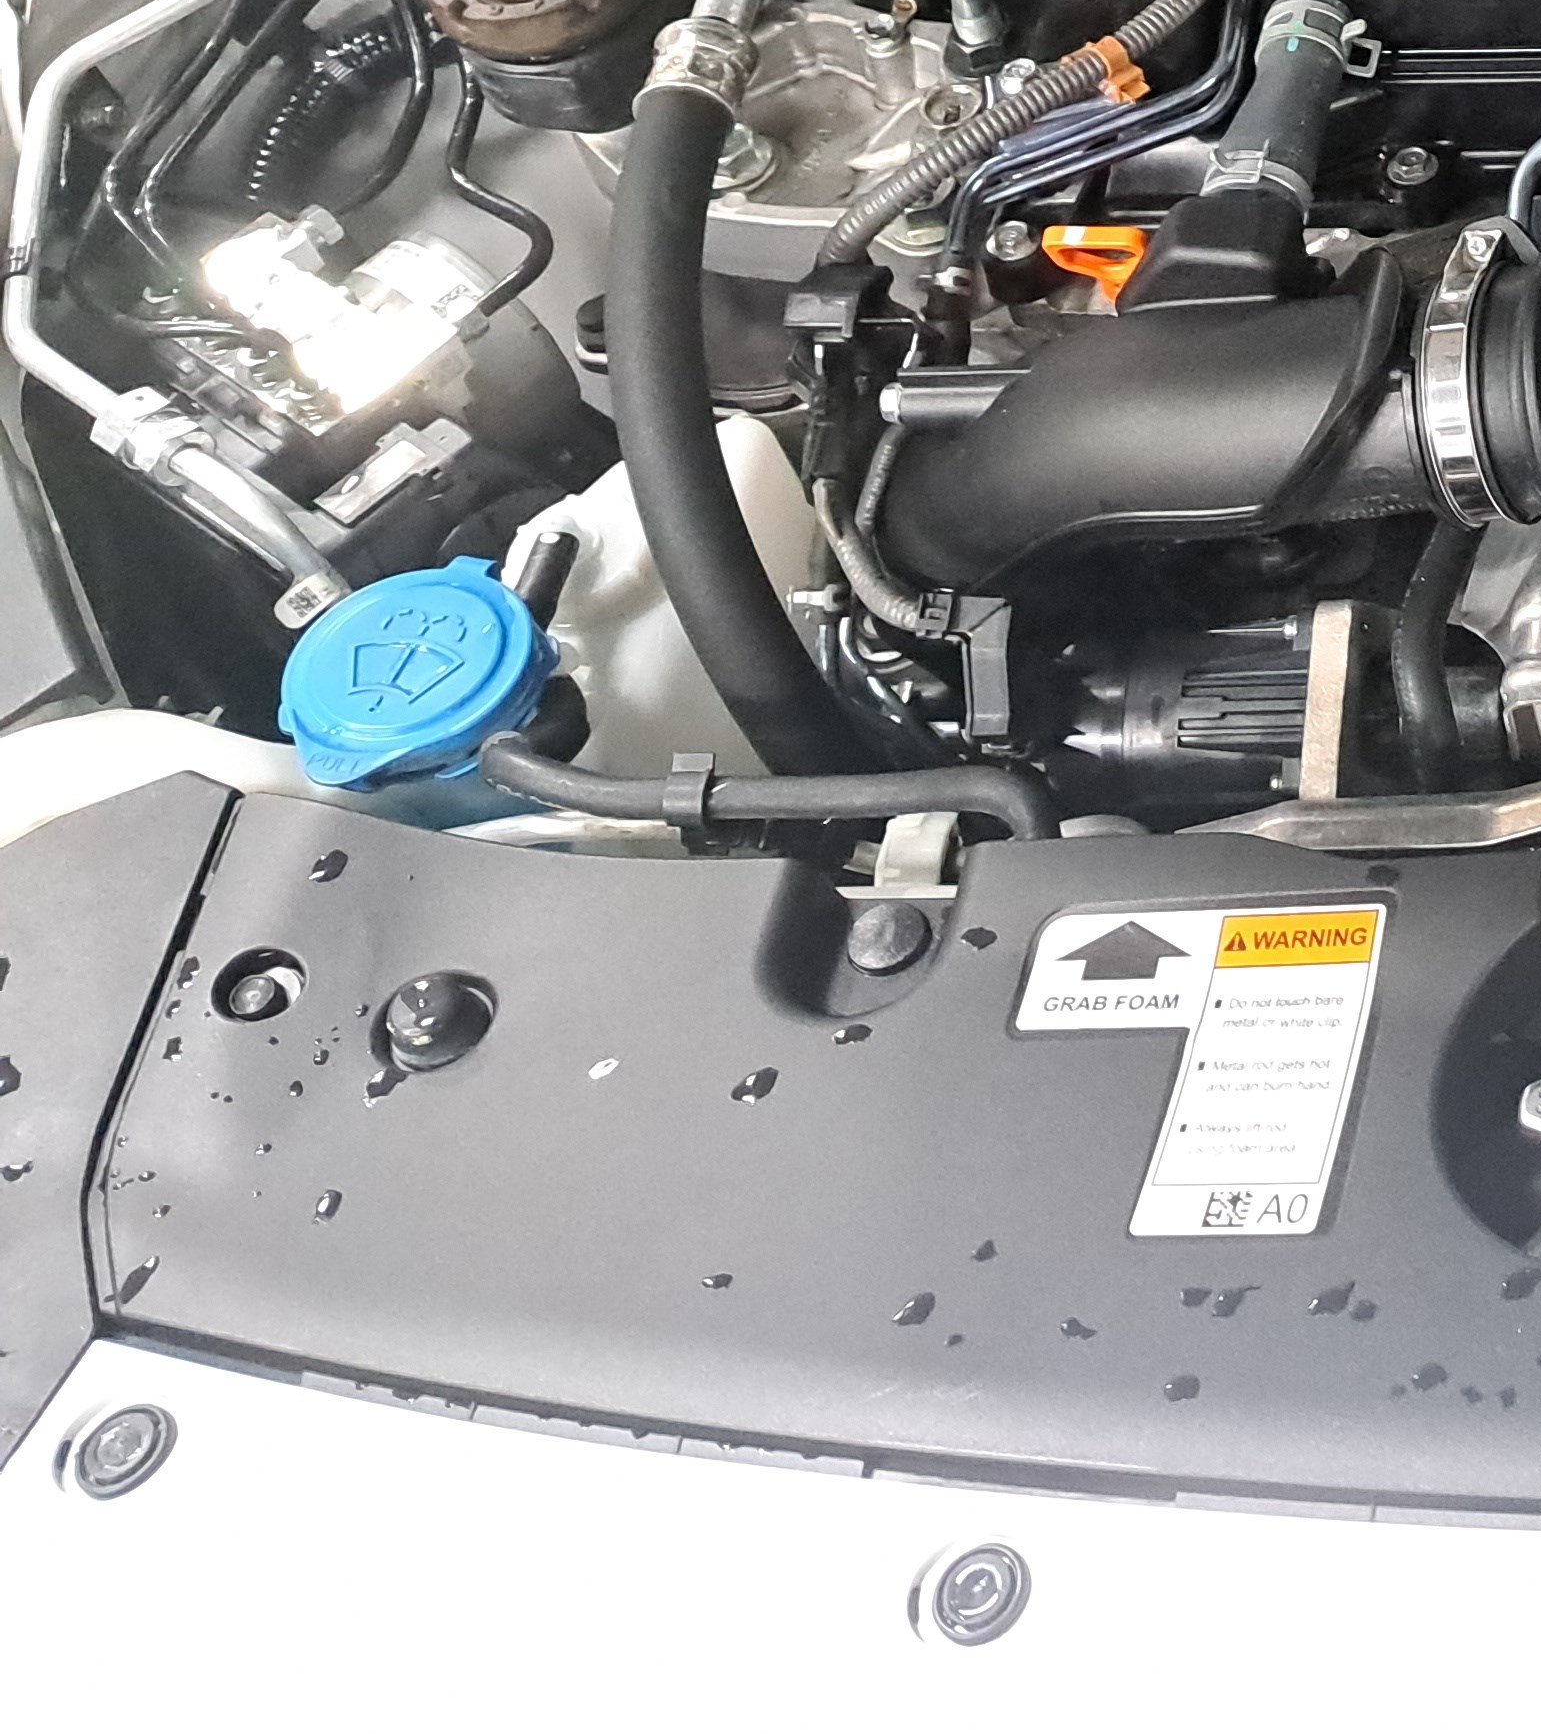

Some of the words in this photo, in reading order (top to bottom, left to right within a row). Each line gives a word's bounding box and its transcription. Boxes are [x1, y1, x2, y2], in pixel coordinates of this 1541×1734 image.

[1253, 927, 1368, 950] WARNING
[1043, 995, 1107, 1012] GRAB
[1115, 994, 1180, 1011] FOAM
[1229, 998, 1247, 1009] Do
